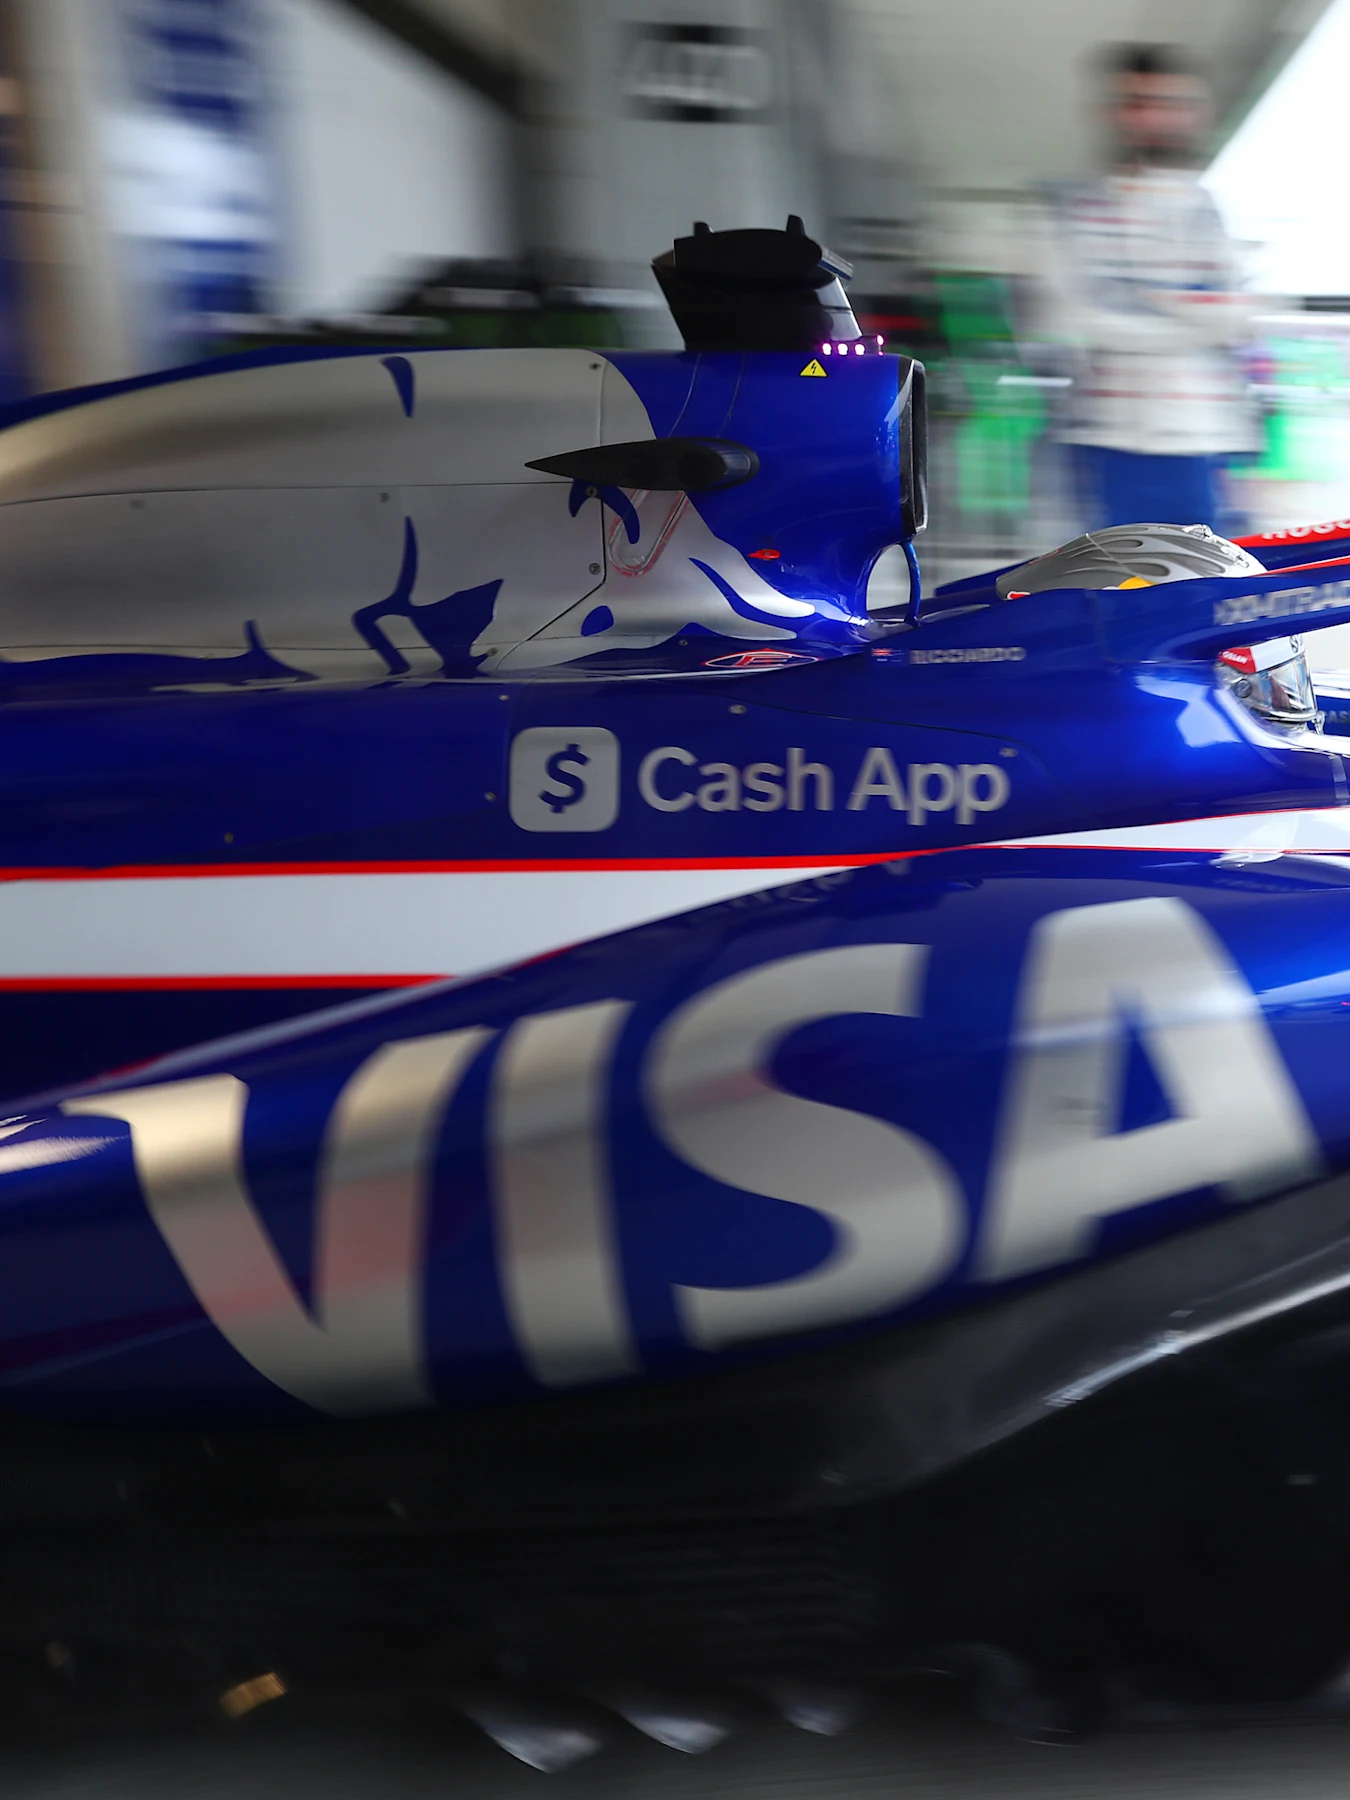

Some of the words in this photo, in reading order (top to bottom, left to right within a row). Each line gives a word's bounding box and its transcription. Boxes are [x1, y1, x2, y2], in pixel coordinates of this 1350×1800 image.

[637, 746, 835, 812] Cash
[848, 746, 1011, 826] App
[60, 895, 1326, 1420] VISA
